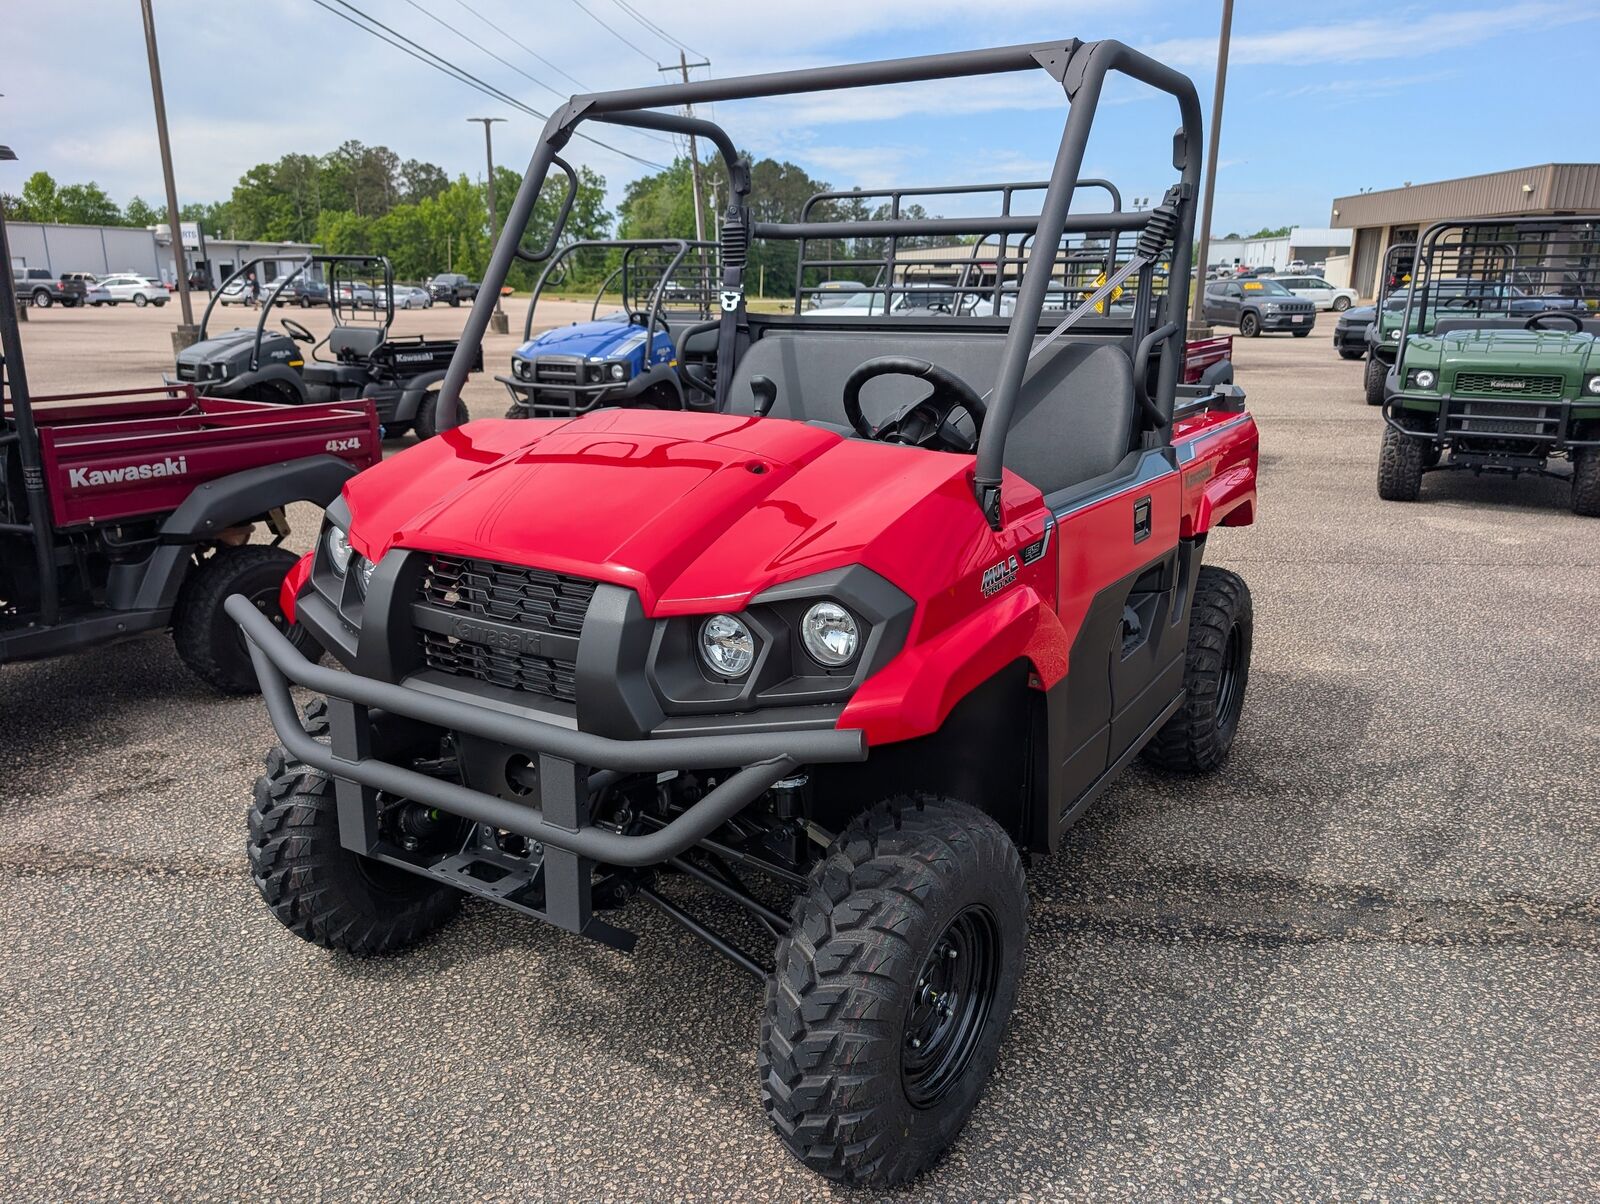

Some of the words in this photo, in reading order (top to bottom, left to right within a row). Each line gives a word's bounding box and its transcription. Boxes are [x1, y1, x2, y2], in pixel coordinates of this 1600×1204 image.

[395, 352, 434, 362] Kawasaki
[1490, 380, 1526, 389] Kawasaki
[325, 437, 361, 452] 4x4
[69, 456, 187, 488] Kawasaki
[980, 554, 1020, 593] MULE
[451, 614, 542, 655] Kawasaki
